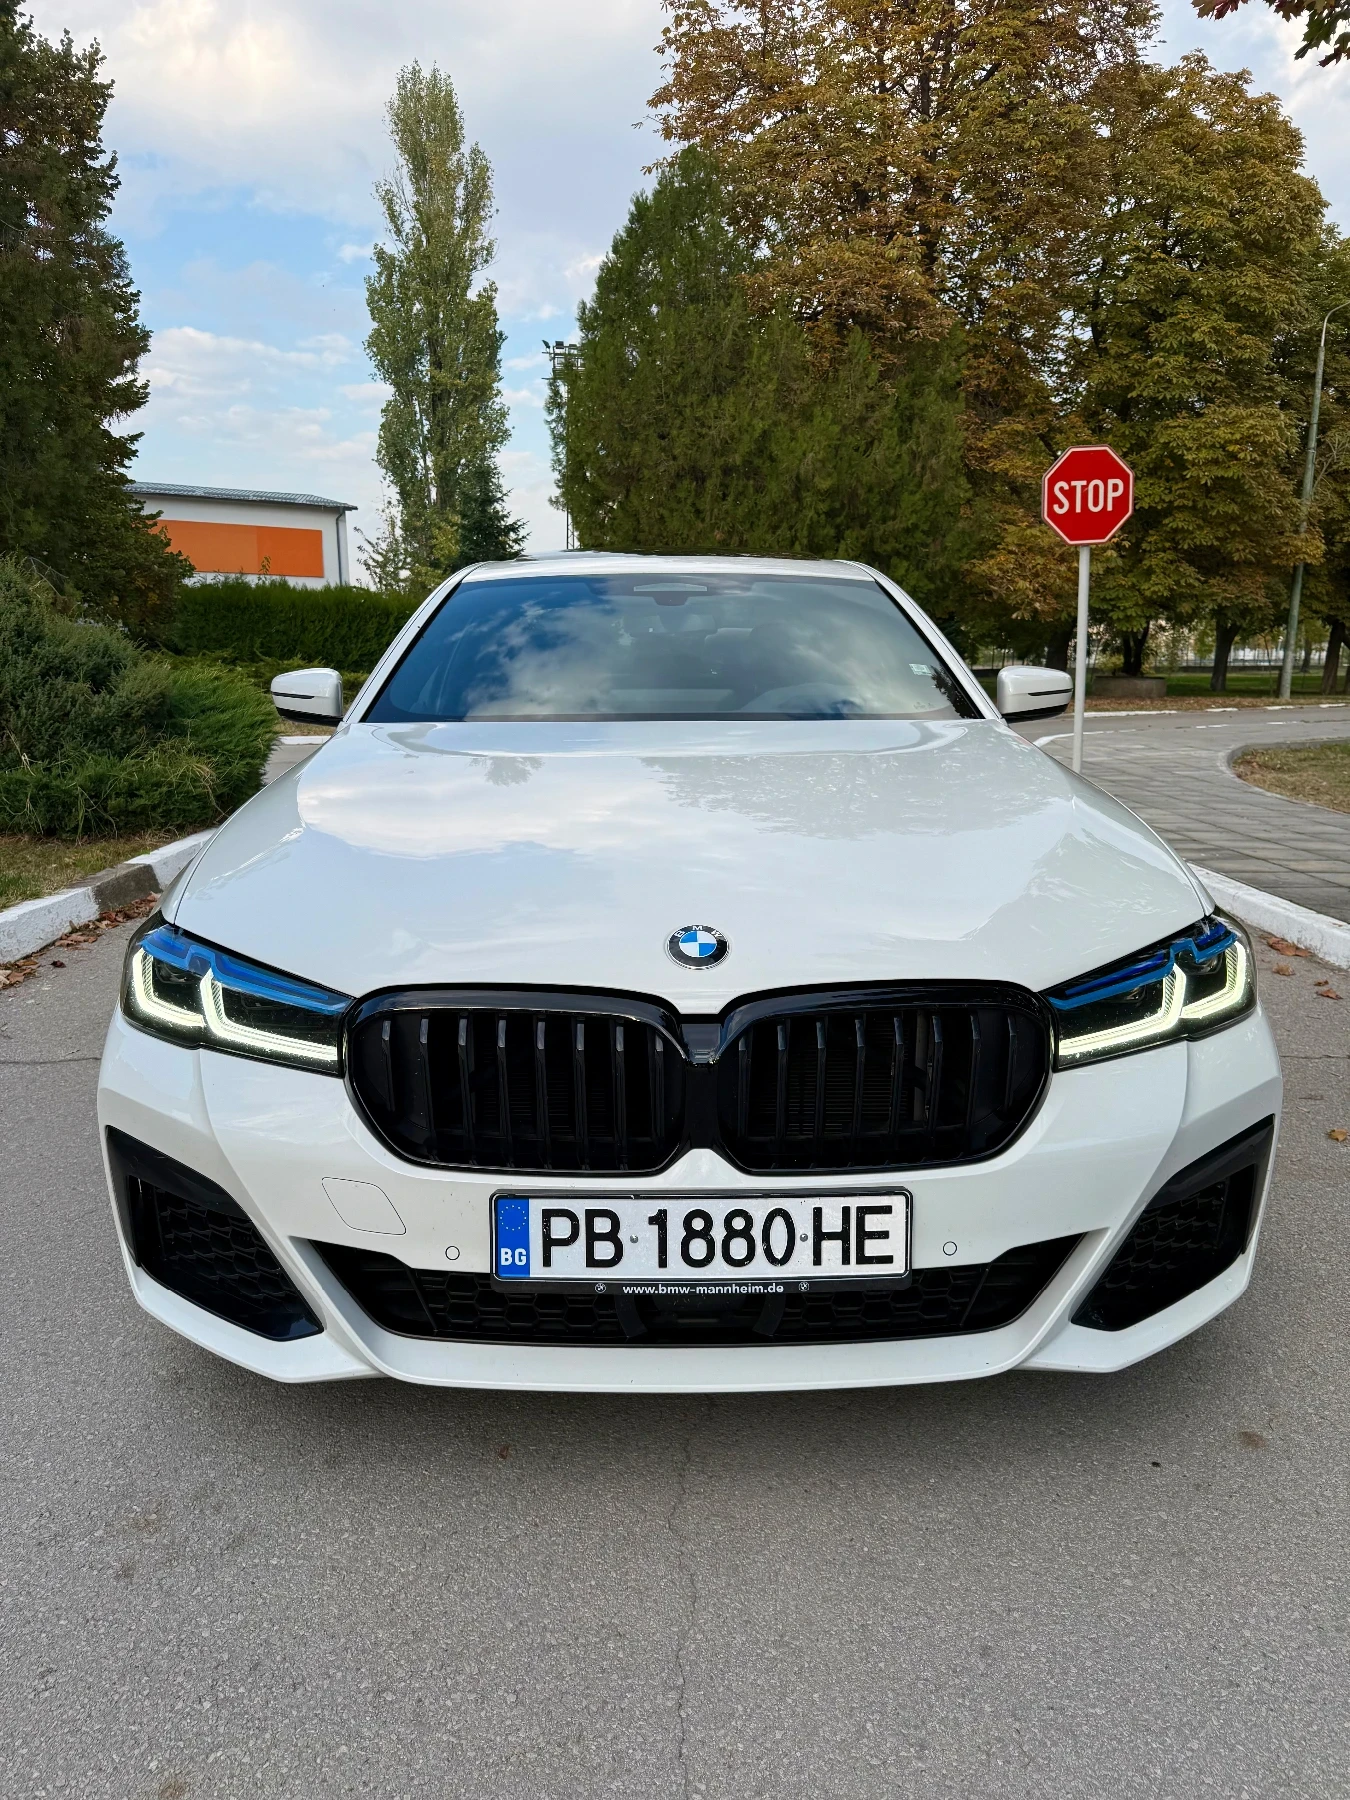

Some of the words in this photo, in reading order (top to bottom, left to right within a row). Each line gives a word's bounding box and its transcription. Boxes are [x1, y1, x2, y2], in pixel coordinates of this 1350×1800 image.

[1053, 479, 1124, 515] STOP
[541, 1208, 624, 1268] PB
[647, 1207, 796, 1268] 1880
[812, 1204, 894, 1266] HE
[500, 1247, 527, 1266] BG
[622, 1282, 784, 1294] www.bmw-mannheim.de
